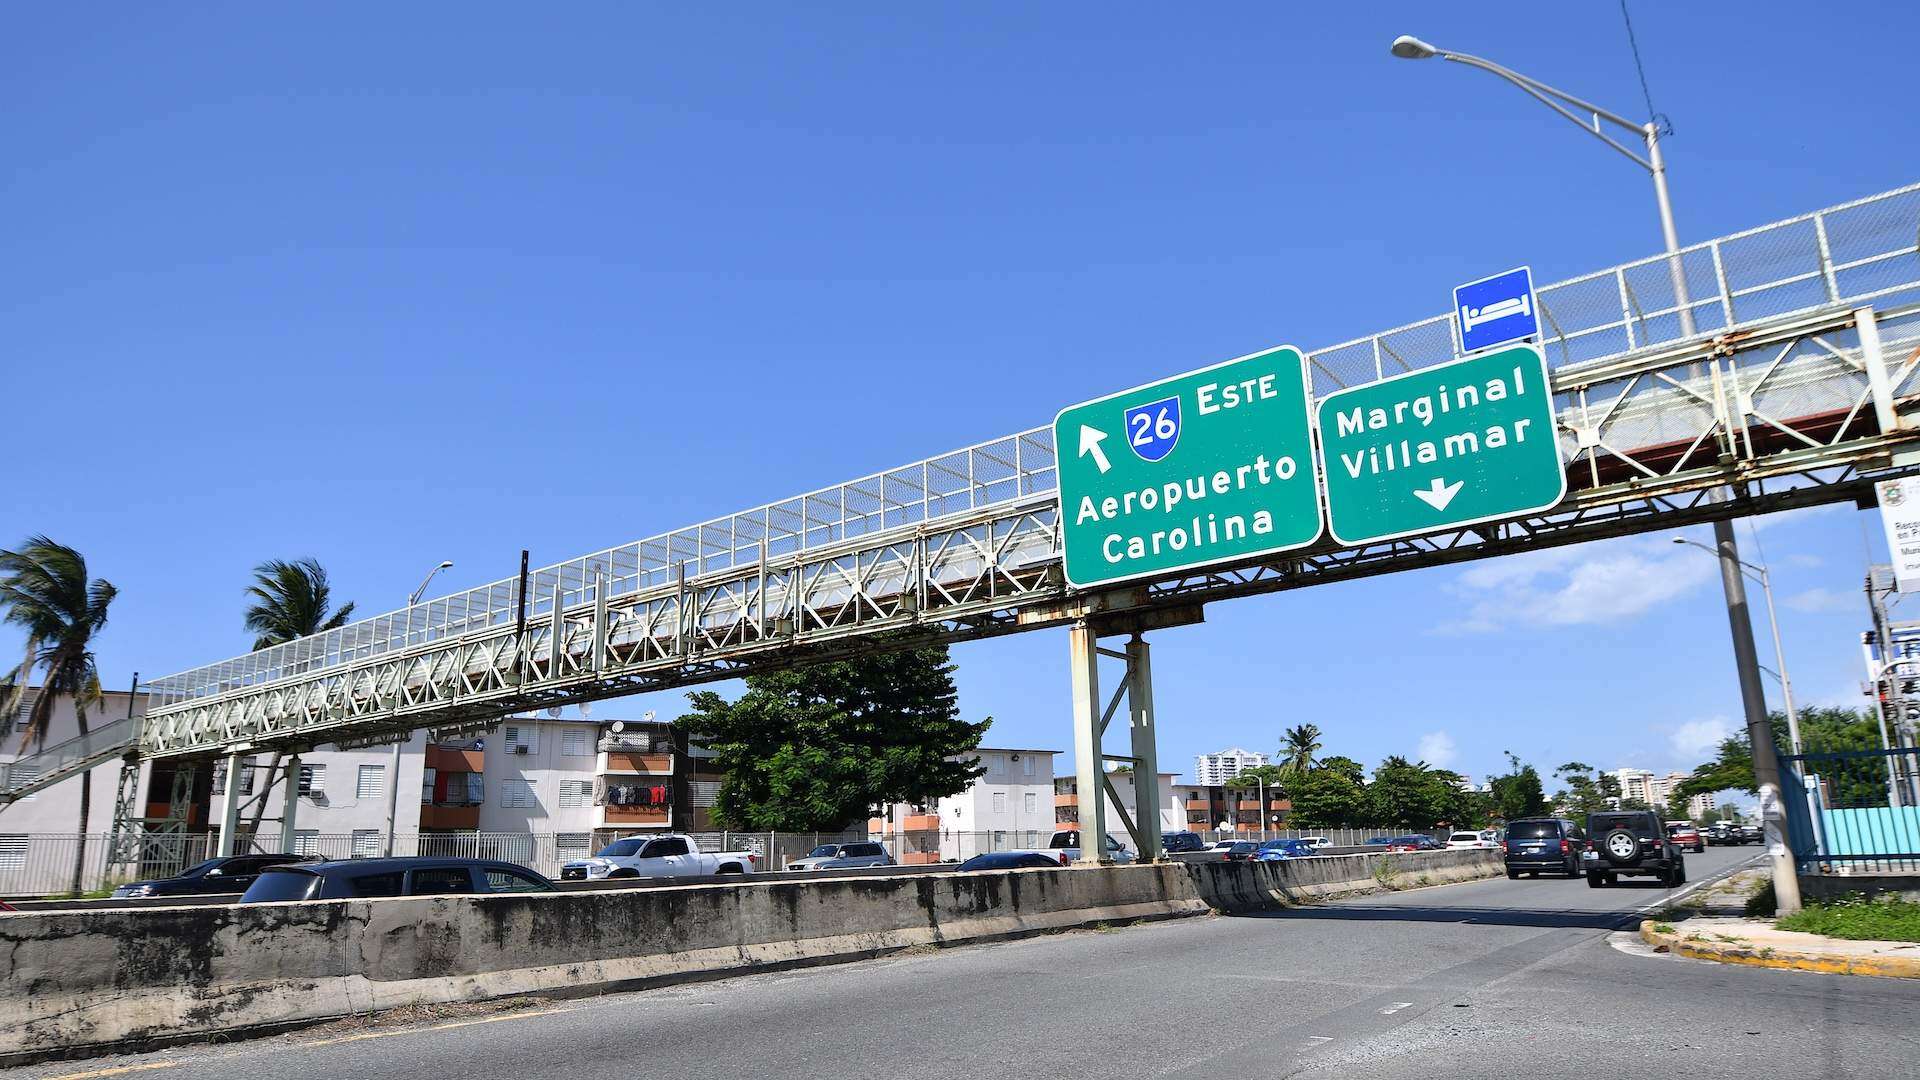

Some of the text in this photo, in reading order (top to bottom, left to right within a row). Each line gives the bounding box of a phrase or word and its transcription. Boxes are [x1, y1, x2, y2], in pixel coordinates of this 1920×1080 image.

[1196, 373, 1278, 416] ESTE
[1336, 366, 1526, 438] Marginal
[1131, 406, 1177, 447] 26
[1340, 418, 1532, 479] Villamar
[1075, 456, 1297, 526] Aeropuerto
[1102, 510, 1274, 564] Carolina
